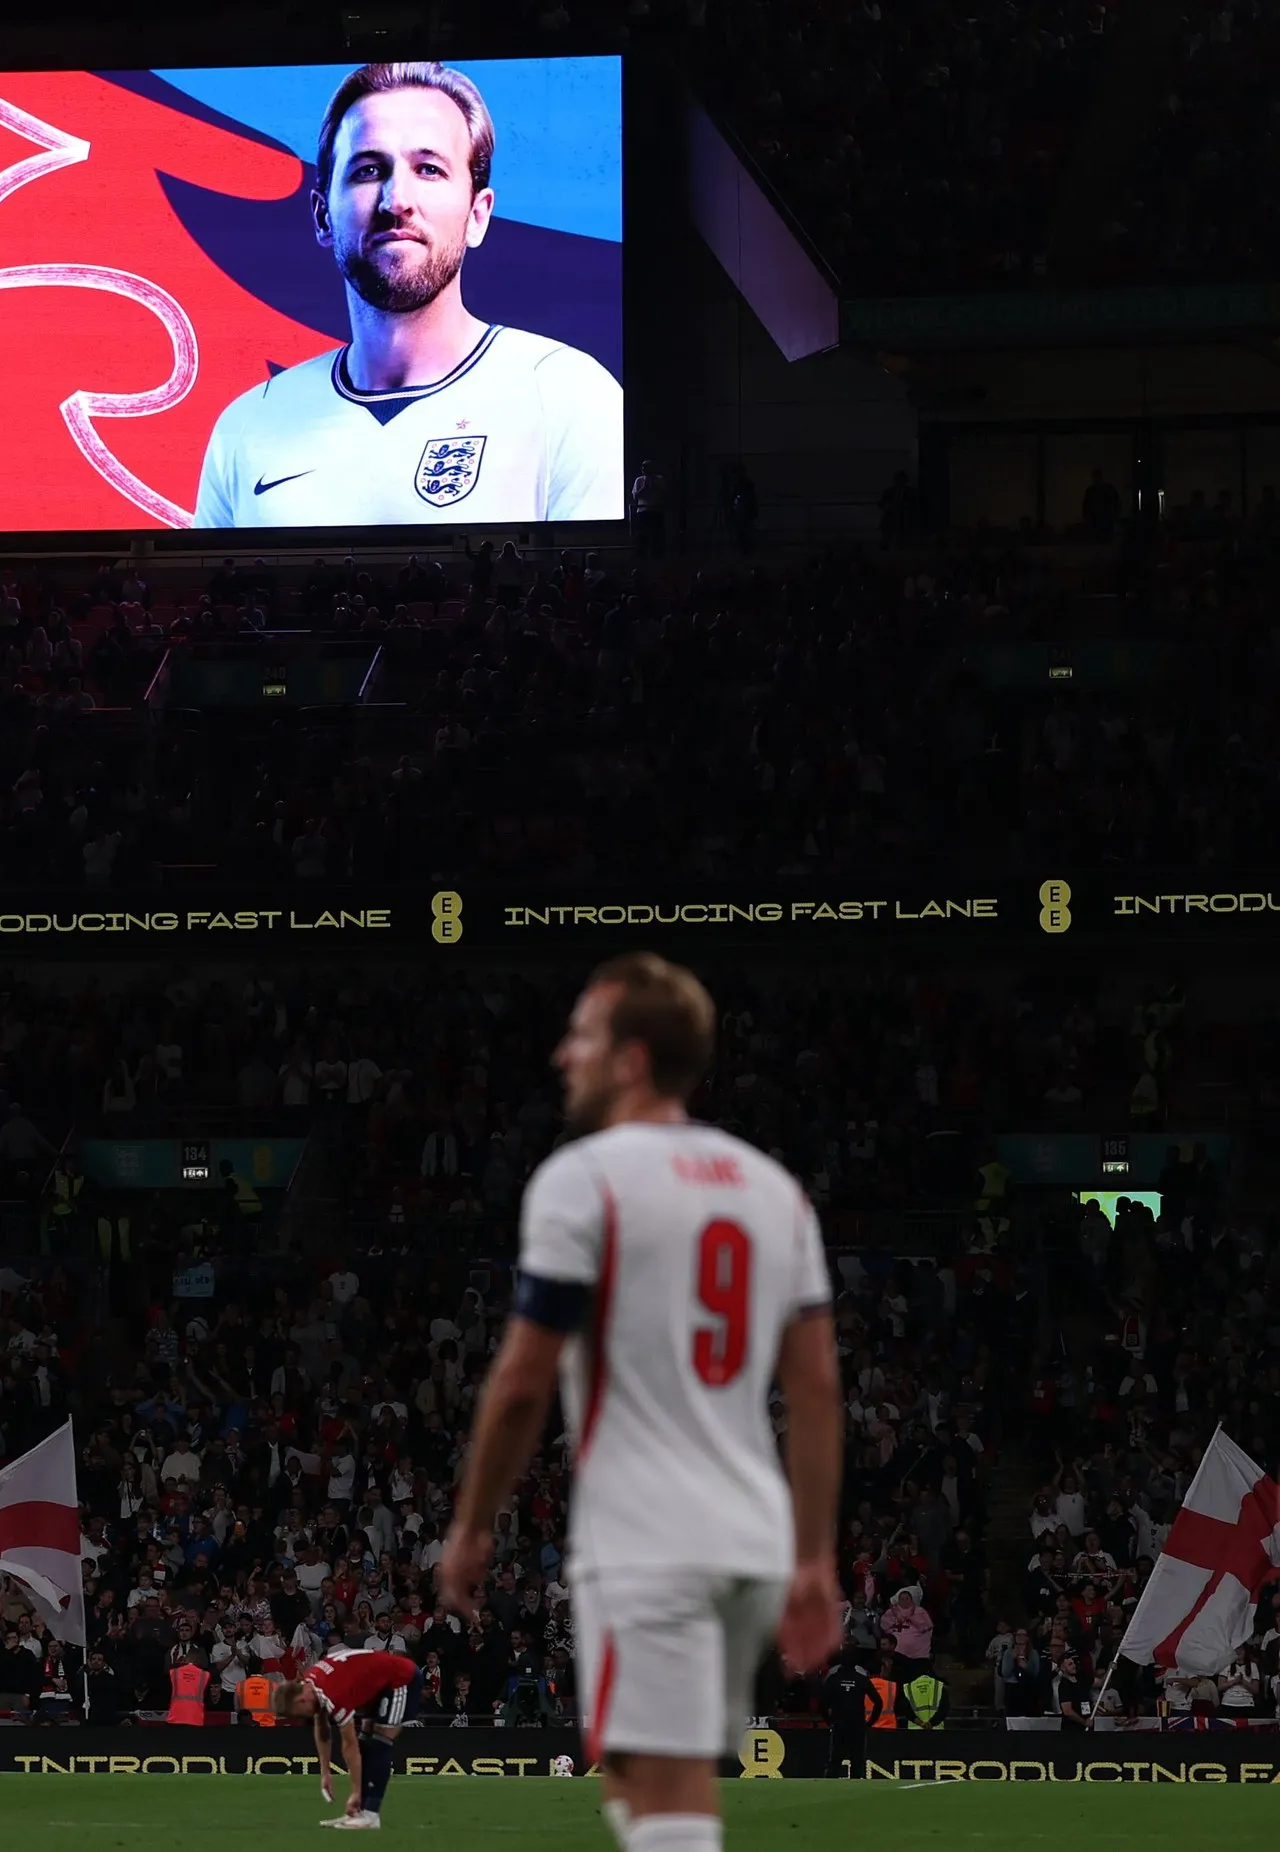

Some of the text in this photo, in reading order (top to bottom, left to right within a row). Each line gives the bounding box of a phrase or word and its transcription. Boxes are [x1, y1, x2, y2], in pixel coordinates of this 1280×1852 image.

[187, 912, 282, 930] FAST
[290, 910, 390, 929] LANE
[504, 899, 998, 925] INTRODUCING FAST LANE
[184, 1146, 207, 1161] 134
[1103, 1140, 1126, 1155] 135
[691, 1216, 751, 1388] 9
[407, 1758, 537, 1777] FAST
